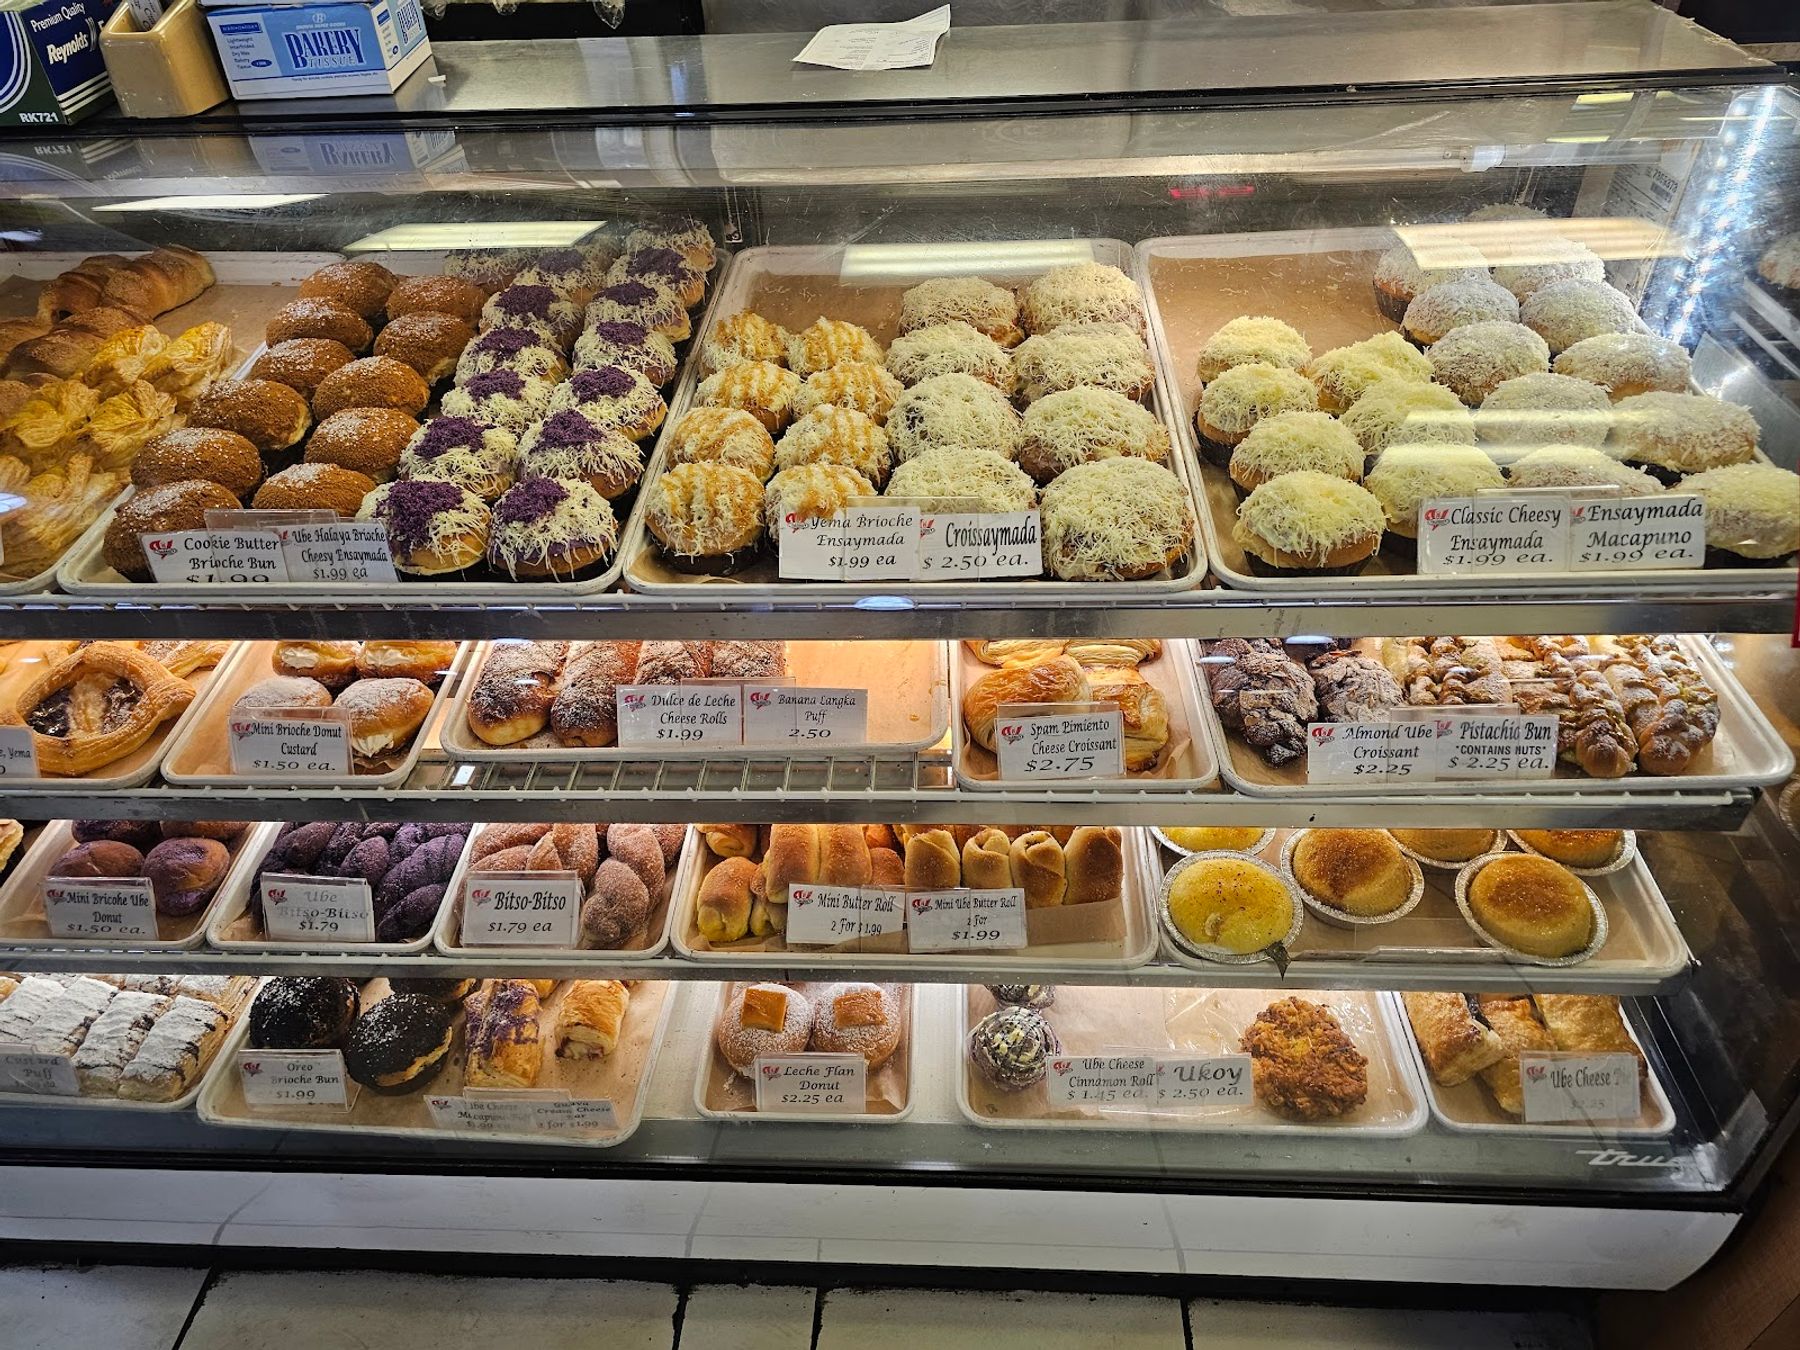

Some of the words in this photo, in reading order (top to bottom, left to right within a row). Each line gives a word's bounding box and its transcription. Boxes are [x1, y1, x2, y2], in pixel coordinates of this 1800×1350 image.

[30, 13, 63, 33] Premium
[60, 2, 86, 21] Quality
[46, 31, 89, 65] Reynolds
[285, 29, 364, 69] BAKERY
[308, 56, 356, 68] TISSUE
[19, 112, 59, 123] RK721
[1451, 505, 1503, 525] Classic
[1508, 503, 1562, 529] Cheesy
[1587, 495, 1704, 526] Ensaymada
[810, 516, 852, 530] Yema
[856, 512, 913, 528] Brioche
[184, 534, 230, 550] Cookie
[234, 536, 279, 550] Butter
[291, 528, 312, 544] Ube
[313, 526, 350, 546] Halaya
[352, 527, 386, 542] Brioche
[816, 531, 905, 551] Ensaymada
[945, 515, 1037, 556] Croissaymada
[1450, 529, 1544, 556] Ensaymada
[1586, 529, 1692, 552] Macapuno
[188, 554, 244, 570] Brioche
[247, 556, 276, 569] Bun
[301, 547, 334, 566] Cheesy
[335, 547, 388, 565] Ensaymada
[828, 555, 870, 569] $1.99
[876, 554, 897, 566] ea
[996, 551, 1029, 566] ea.
[1442, 554, 1506, 567] $1.99
[1516, 552, 1553, 563] ea.
[1578, 549, 1643, 563] $1.99
[1654, 547, 1694, 559] ea.
[313, 567, 347, 580] $1.99
[352, 567, 369, 580] ea
[651, 692, 684, 706] Dulce
[688, 692, 701, 707] de
[703, 693, 736, 707] Leche
[778, 694, 817, 705] Banana
[819, 693, 857, 710] Langka
[660, 710, 697, 725] Cheese
[699, 710, 728, 725] Rolls
[804, 708, 829, 726] Puff
[250, 722, 274, 735] Mini
[275, 722, 311, 737] Brioche
[312, 724, 342, 738] Donut
[656, 728, 704, 741] $1.99
[788, 728, 832, 740] 2.50
[1030, 723, 1059, 741] Spam
[1061, 717, 1110, 735] Pimiento
[1342, 725, 1402, 740] Almond
[1404, 725, 1433, 739] Ube
[1459, 718, 1521, 741] Pistachio
[1524, 721, 1552, 740] Bun
[281, 742, 318, 756] Custard
[1031, 740, 1066, 756] Cheese
[1068, 737, 1118, 753] Croissant
[1353, 745, 1420, 759] Croissant
[252, 760, 299, 771] $1.50
[307, 762, 336, 771] ea.
[1024, 756, 1096, 772] $2.75
[1353, 763, 1413, 776] $2.25
[1517, 756, 1549, 769] ea.
[66, 891, 90, 905] Mini
[130, 893, 149, 907] Ube
[303, 890, 338, 903] Ube
[494, 890, 566, 911] Bitso-Bitso
[818, 892, 841, 908] Mini
[842, 894, 873, 910] Butter
[874, 896, 896, 912] Roll
[934, 899, 954, 910] Mini
[955, 897, 970, 909] Ube
[973, 897, 998, 909] Butter
[1000, 895, 1017, 908] Roll
[92, 911, 122, 924] Donut
[67, 923, 112, 933] $1.50
[119, 924, 146, 934] ea.
[299, 920, 339, 932] $1.79
[488, 922, 527, 934] $1.79
[533, 922, 552, 932] ea
[831, 920, 837, 931] 2
[952, 930, 1000, 941] $1.99
[287, 1063, 313, 1072] Oreo
[784, 1066, 820, 1076] Leche
[823, 1065, 855, 1077] Flan
[1082, 1057, 1105, 1070] Ube
[1108, 1057, 1145, 1070] Cheese
[315, 1076, 339, 1084] Bun
[1068, 1076, 1127, 1088] Cinnamon
[1130, 1073, 1156, 1087] Roll
[1173, 1061, 1243, 1086] Ukoy
[1550, 1066, 1573, 1089] Ube
[1575, 1066, 1611, 1087] Cheese
[799, 1080, 840, 1090] Donut
[1217, 1085, 1244, 1096] ea.
[781, 1094, 820, 1105] $2.25
[825, 1094, 844, 1103] ea
